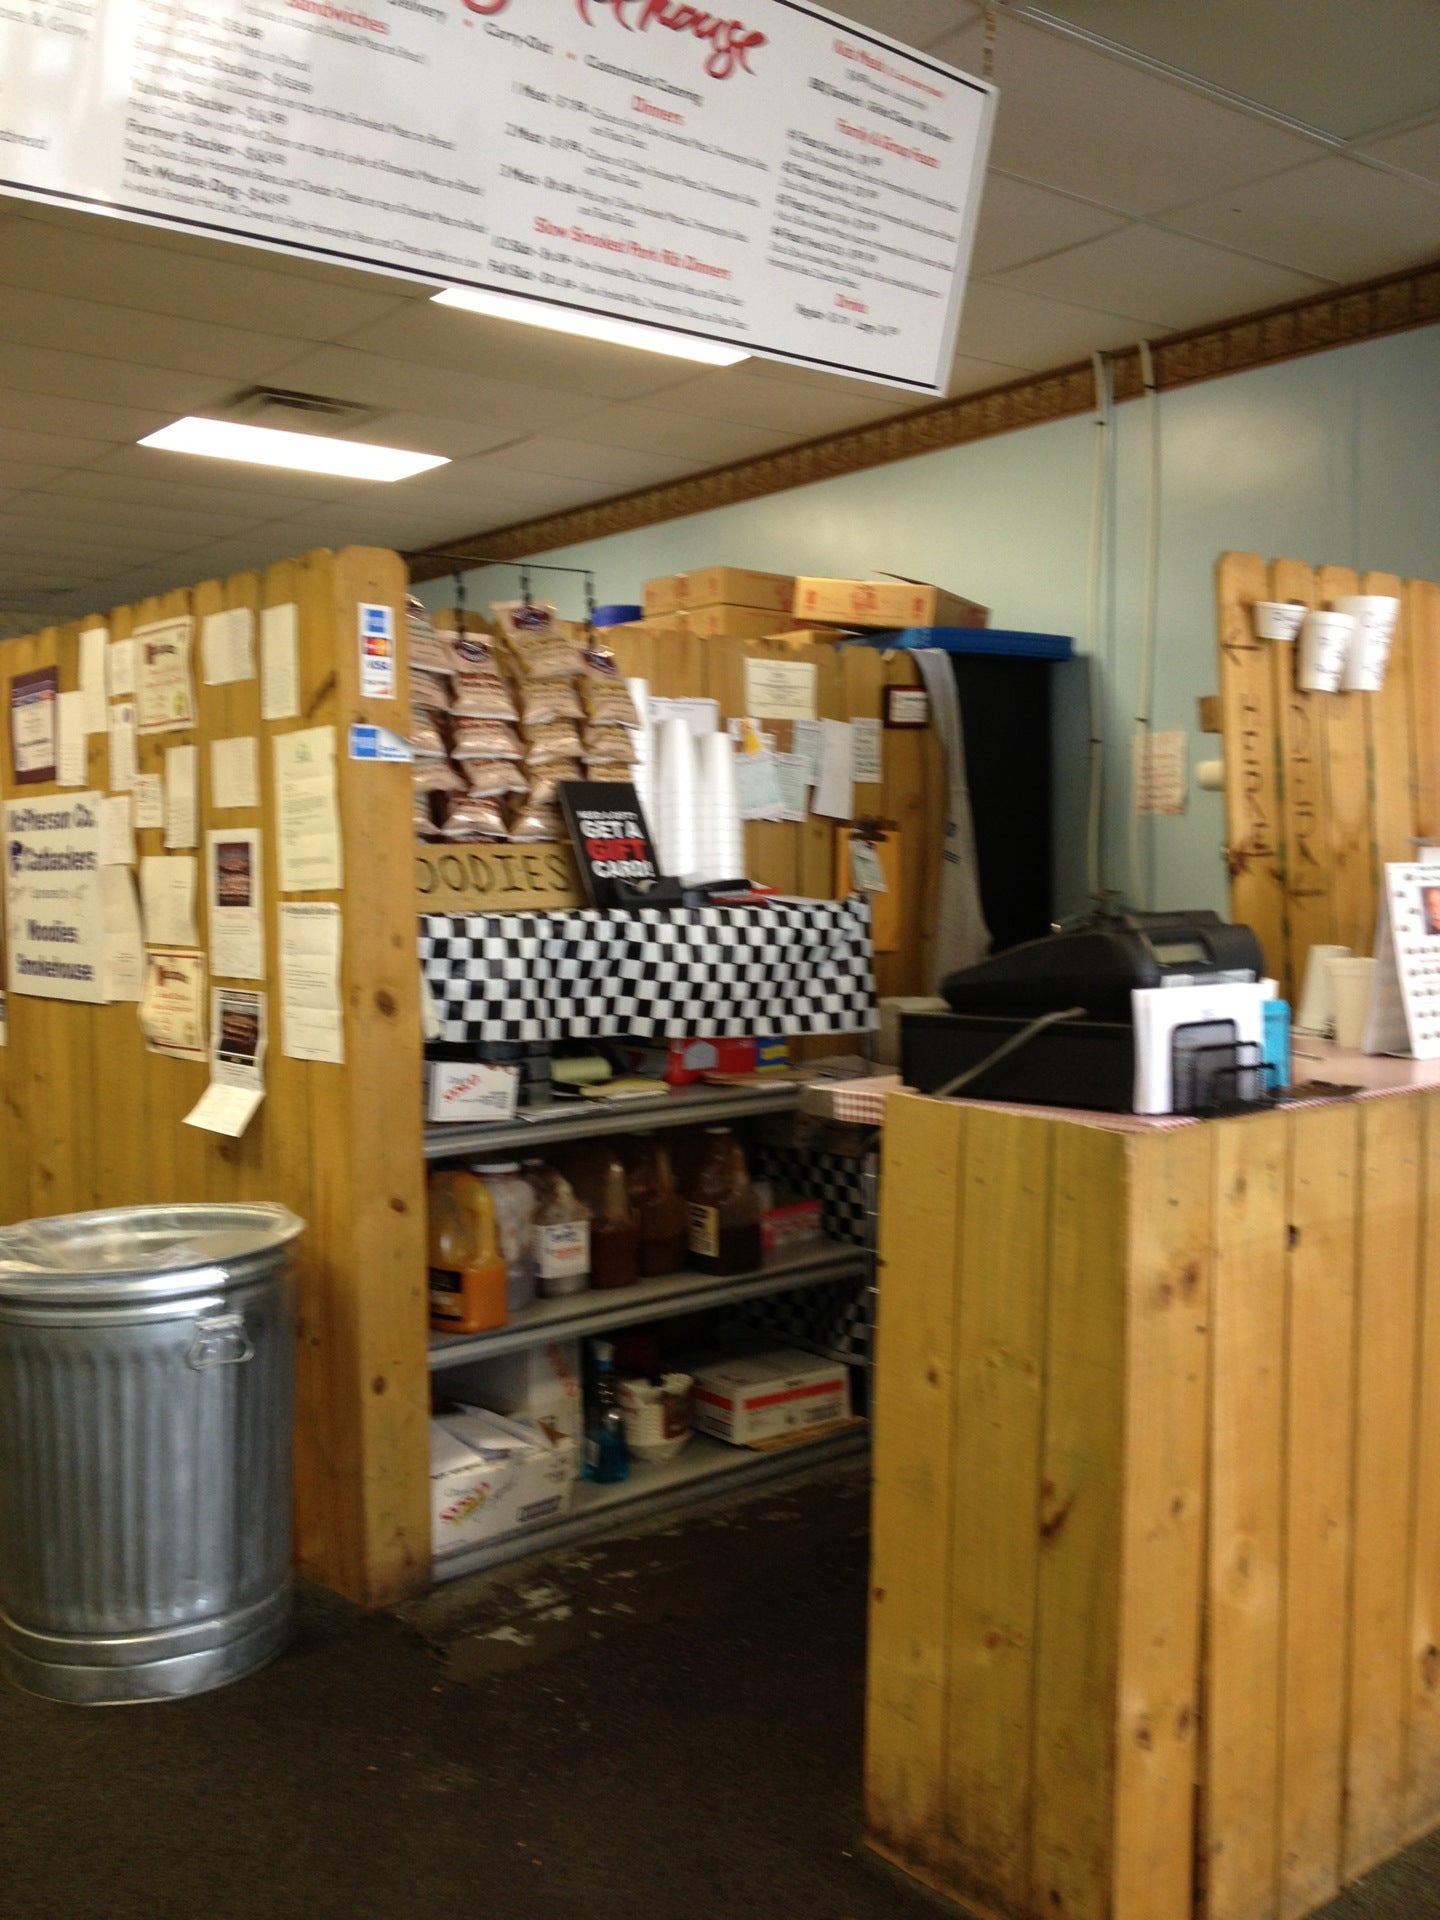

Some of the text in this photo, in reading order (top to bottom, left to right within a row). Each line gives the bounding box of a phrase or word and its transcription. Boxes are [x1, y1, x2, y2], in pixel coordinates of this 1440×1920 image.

[579, 820, 645, 839] GET A
[585, 838, 647, 862] GIFT
[415, 853, 571, 894] OODIES
